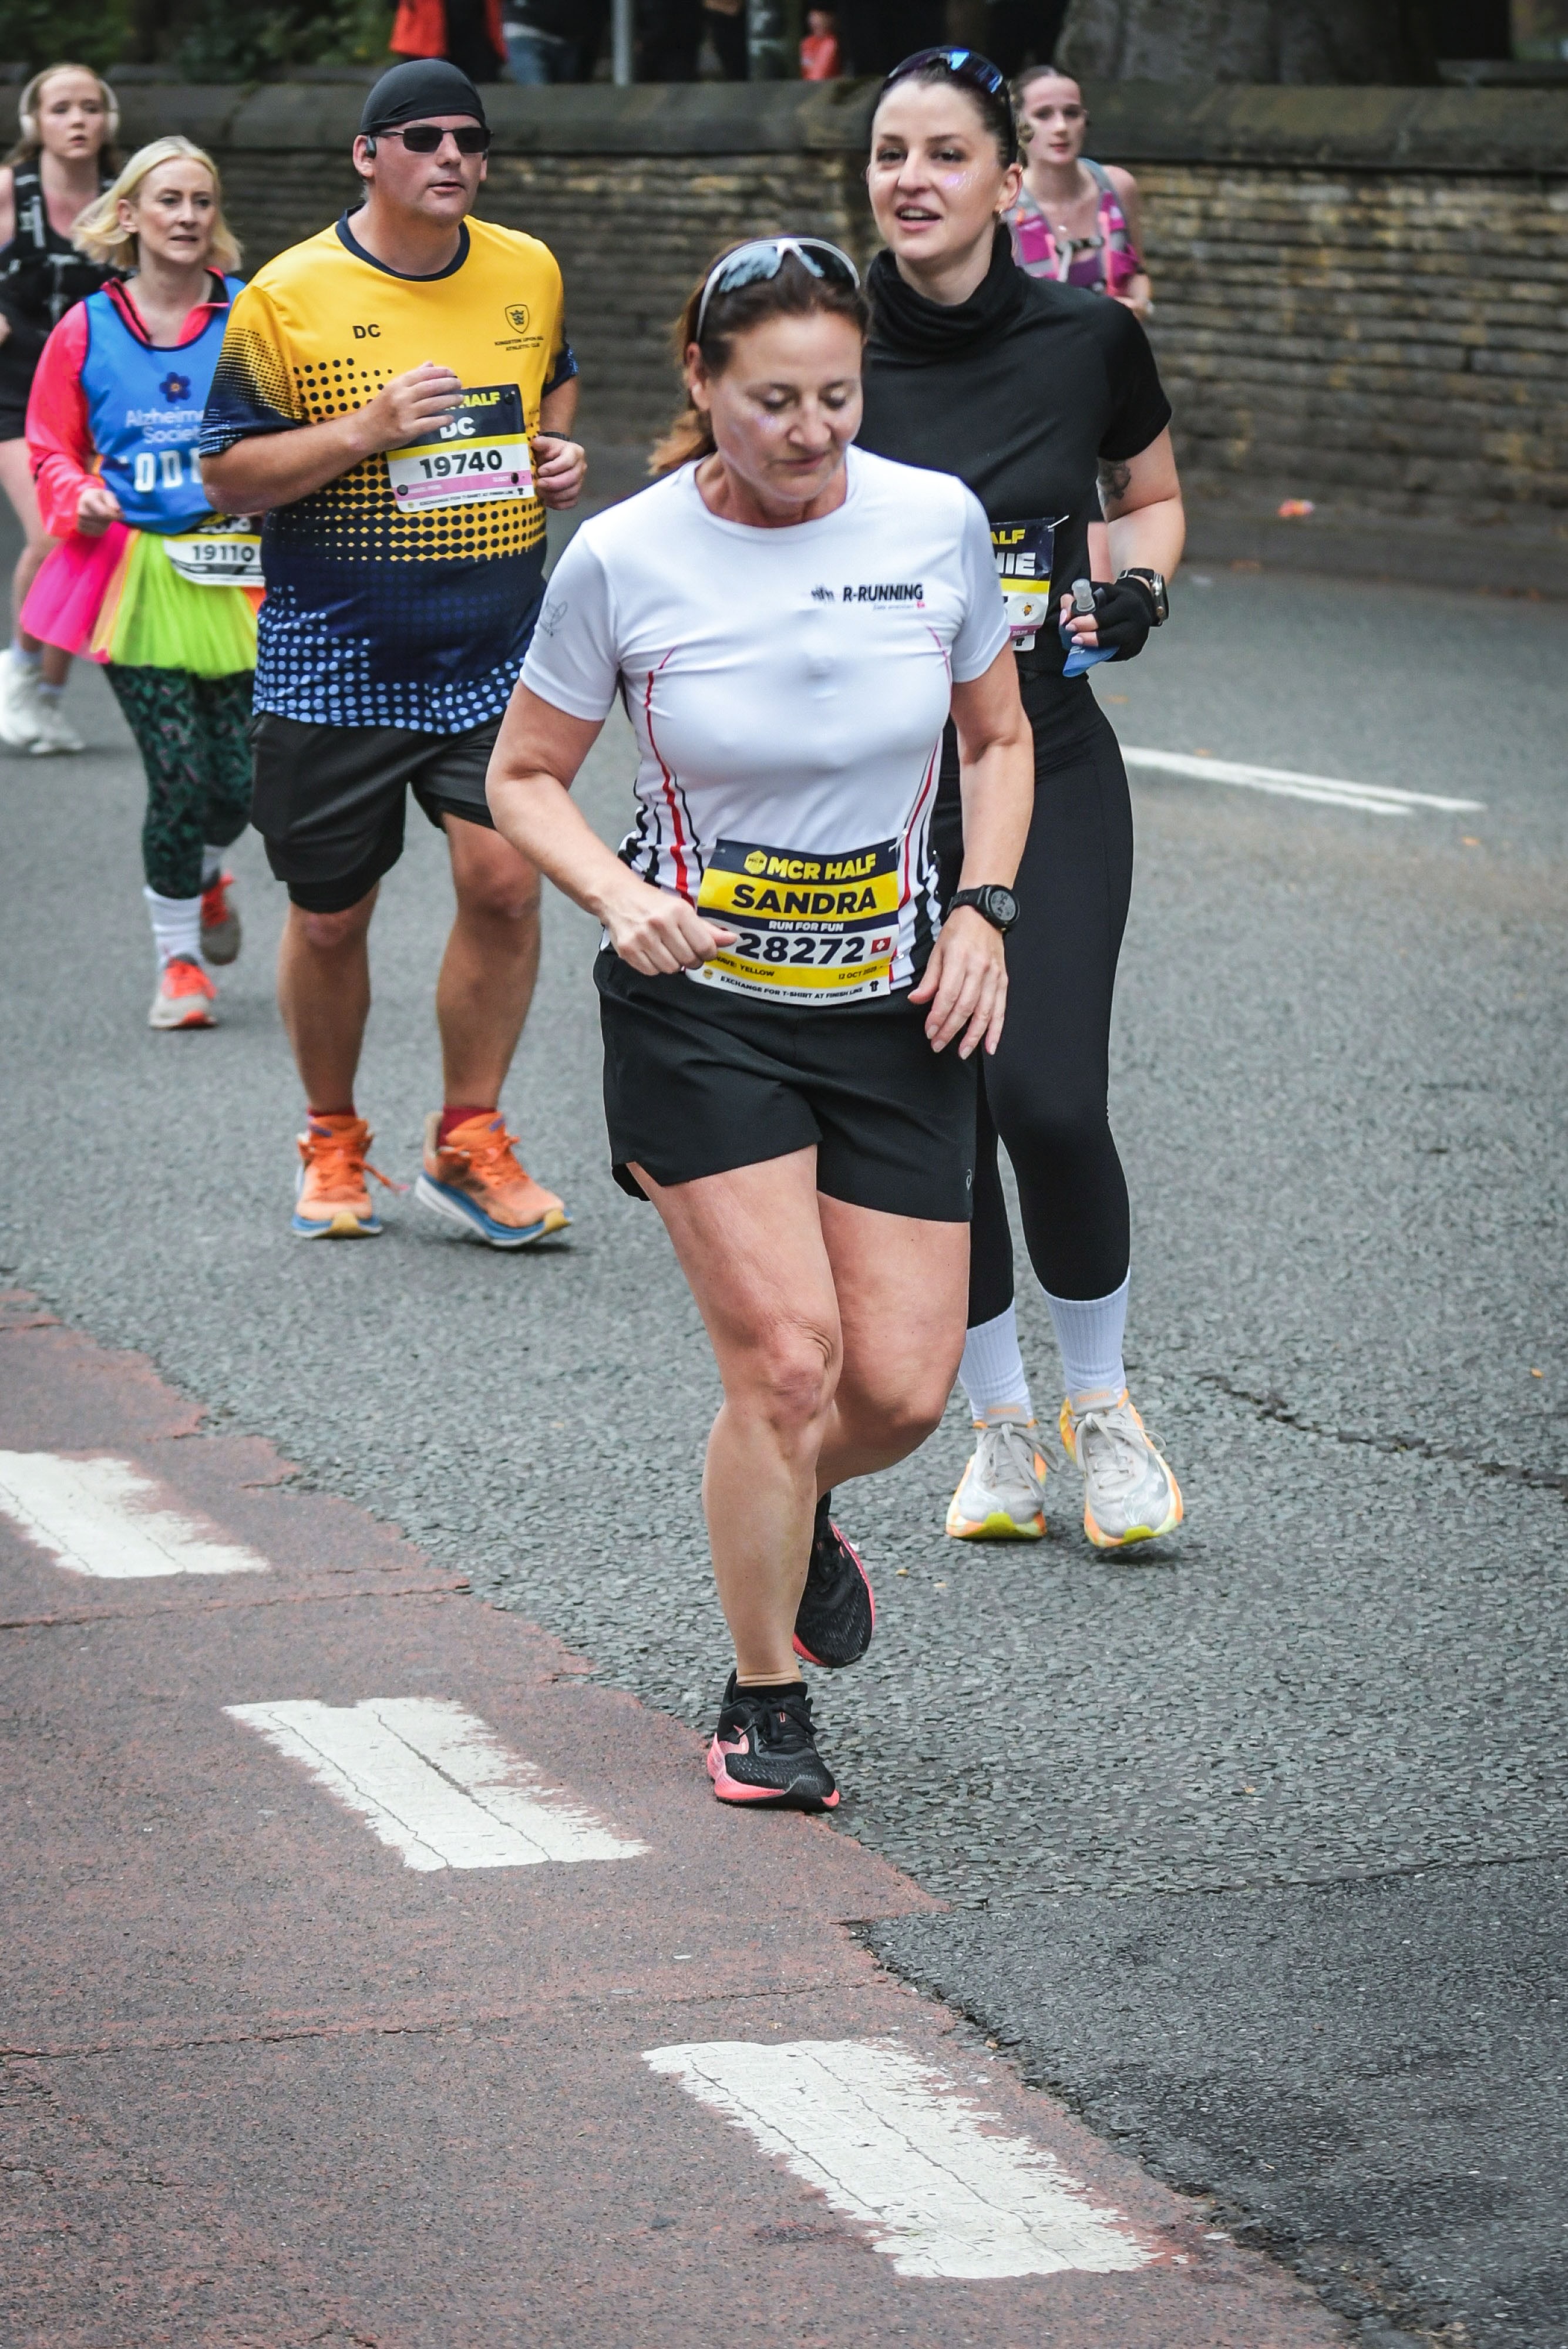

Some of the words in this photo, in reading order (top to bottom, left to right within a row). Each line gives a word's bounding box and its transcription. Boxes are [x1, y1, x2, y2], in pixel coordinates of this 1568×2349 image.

[352, 324, 381, 339] DC
[440, 417, 476, 439] DC
[419, 449, 503, 479] 19740
[193, 544, 255, 562] 19110
[843, 583, 924, 601] R-RUNNING
[767, 856, 821, 880] MCR
[825, 853, 876, 880] HALF
[731, 884, 877, 914] SANDRA
[769, 920, 794, 931] RUN
[795, 922, 819, 931] FOR
[820, 923, 844, 932] FUN
[735, 933, 865, 964] 28272
[741, 965, 775, 977] YELLOW
[846, 971, 862, 979] OCT
[720, 976, 762, 992] EXCHANGE
[764, 988, 780, 996] FOR
